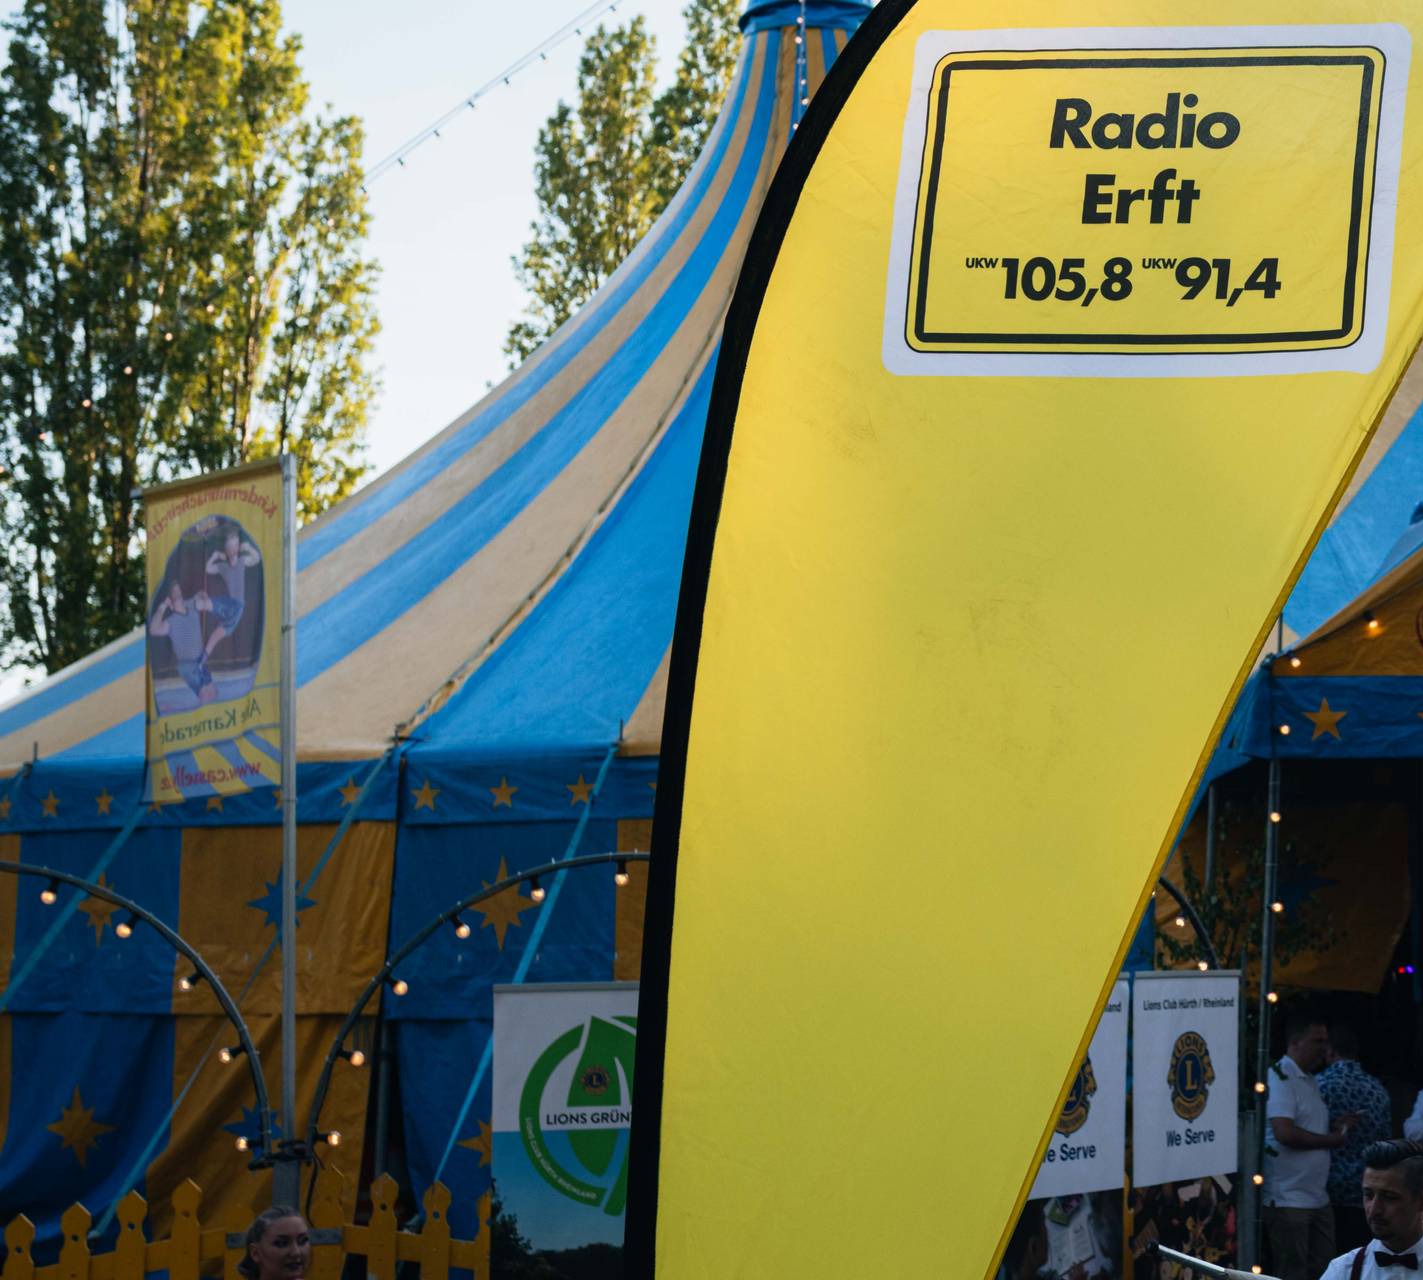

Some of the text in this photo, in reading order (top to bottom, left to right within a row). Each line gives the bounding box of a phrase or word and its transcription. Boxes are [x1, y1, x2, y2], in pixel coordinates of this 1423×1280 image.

[1049, 92, 1241, 149] Radio
[1081, 168, 1201, 224] Erft
[965, 257, 1282, 307] UKW 105,8 UKW 91,4
[1143, 999, 1161, 1011] Lions
[1163, 998, 1177, 1010] Club
[1203, 997, 1235, 1008] Rheinland
[1184, 1060, 1199, 1090] L
[546, 1109, 632, 1125] LIONS GRÜN
[1166, 1128, 1215, 1147] We Serve
[1059, 1143, 1097, 1162] Serve
